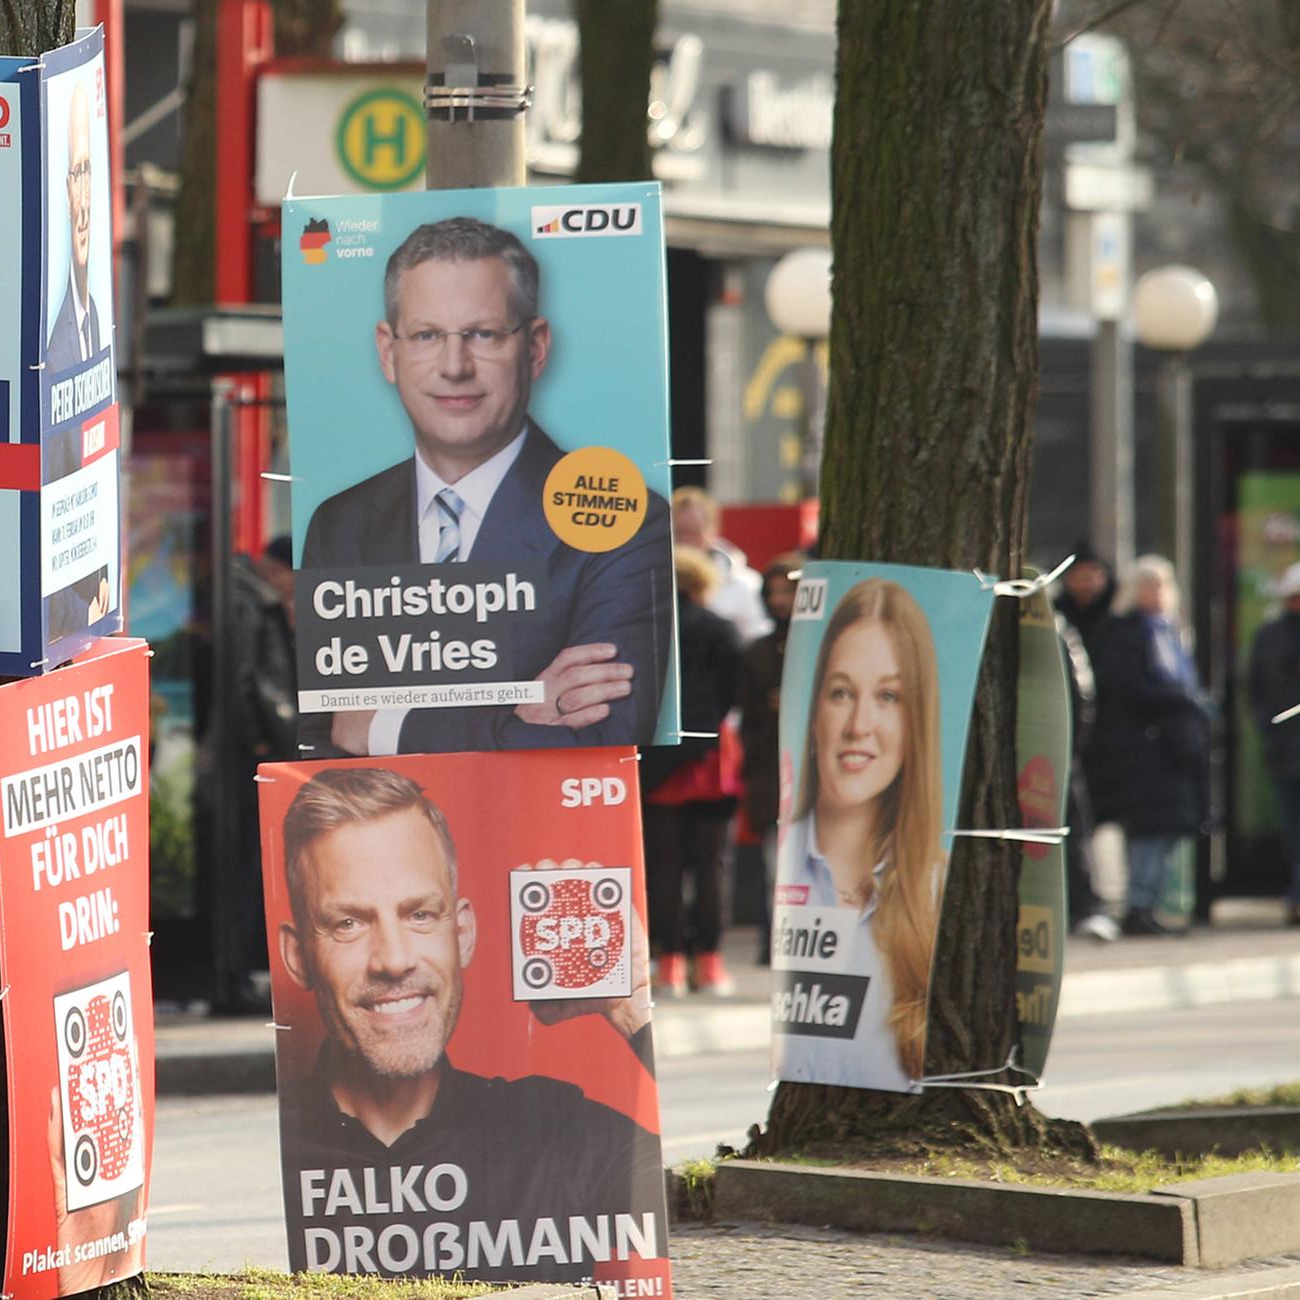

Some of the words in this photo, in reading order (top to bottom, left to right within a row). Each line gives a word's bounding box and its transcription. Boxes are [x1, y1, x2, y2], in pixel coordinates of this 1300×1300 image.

[364, 114, 406, 168] H
[335, 220, 378, 232] Wieder
[561, 207, 637, 233] CDU
[336, 234, 365, 245] nach
[336, 247, 374, 258] vorne
[574, 475, 619, 492] ALLE
[552, 492, 638, 512] STIMMEN
[571, 512, 617, 528] CDU
[312, 572, 536, 623] Christoph
[796, 586, 823, 614] DU
[315, 637, 369, 676] de
[377, 630, 498, 673] Vries
[320, 694, 360, 707] Damit
[364, 696, 378, 706] es
[380, 692, 426, 705] wieder
[430, 689, 493, 703] aufwärts
[497, 687, 533, 702] geht.
[26, 699, 81, 755] HIER
[86, 683, 114, 738] IST
[6, 764, 77, 830] MEHR
[80, 744, 138, 808] NETTO
[560, 777, 626, 808] SPD
[31, 825, 79, 891] FÜR
[83, 813, 129, 877] DICH
[59, 887, 120, 951] DRIN:
[534, 915, 611, 951] SPD
[79, 1053, 127, 1121] SPD
[299, 1162, 468, 1216] FALKO
[22, 1243, 71, 1276] Plakat
[74, 1231, 129, 1264] scannen,
